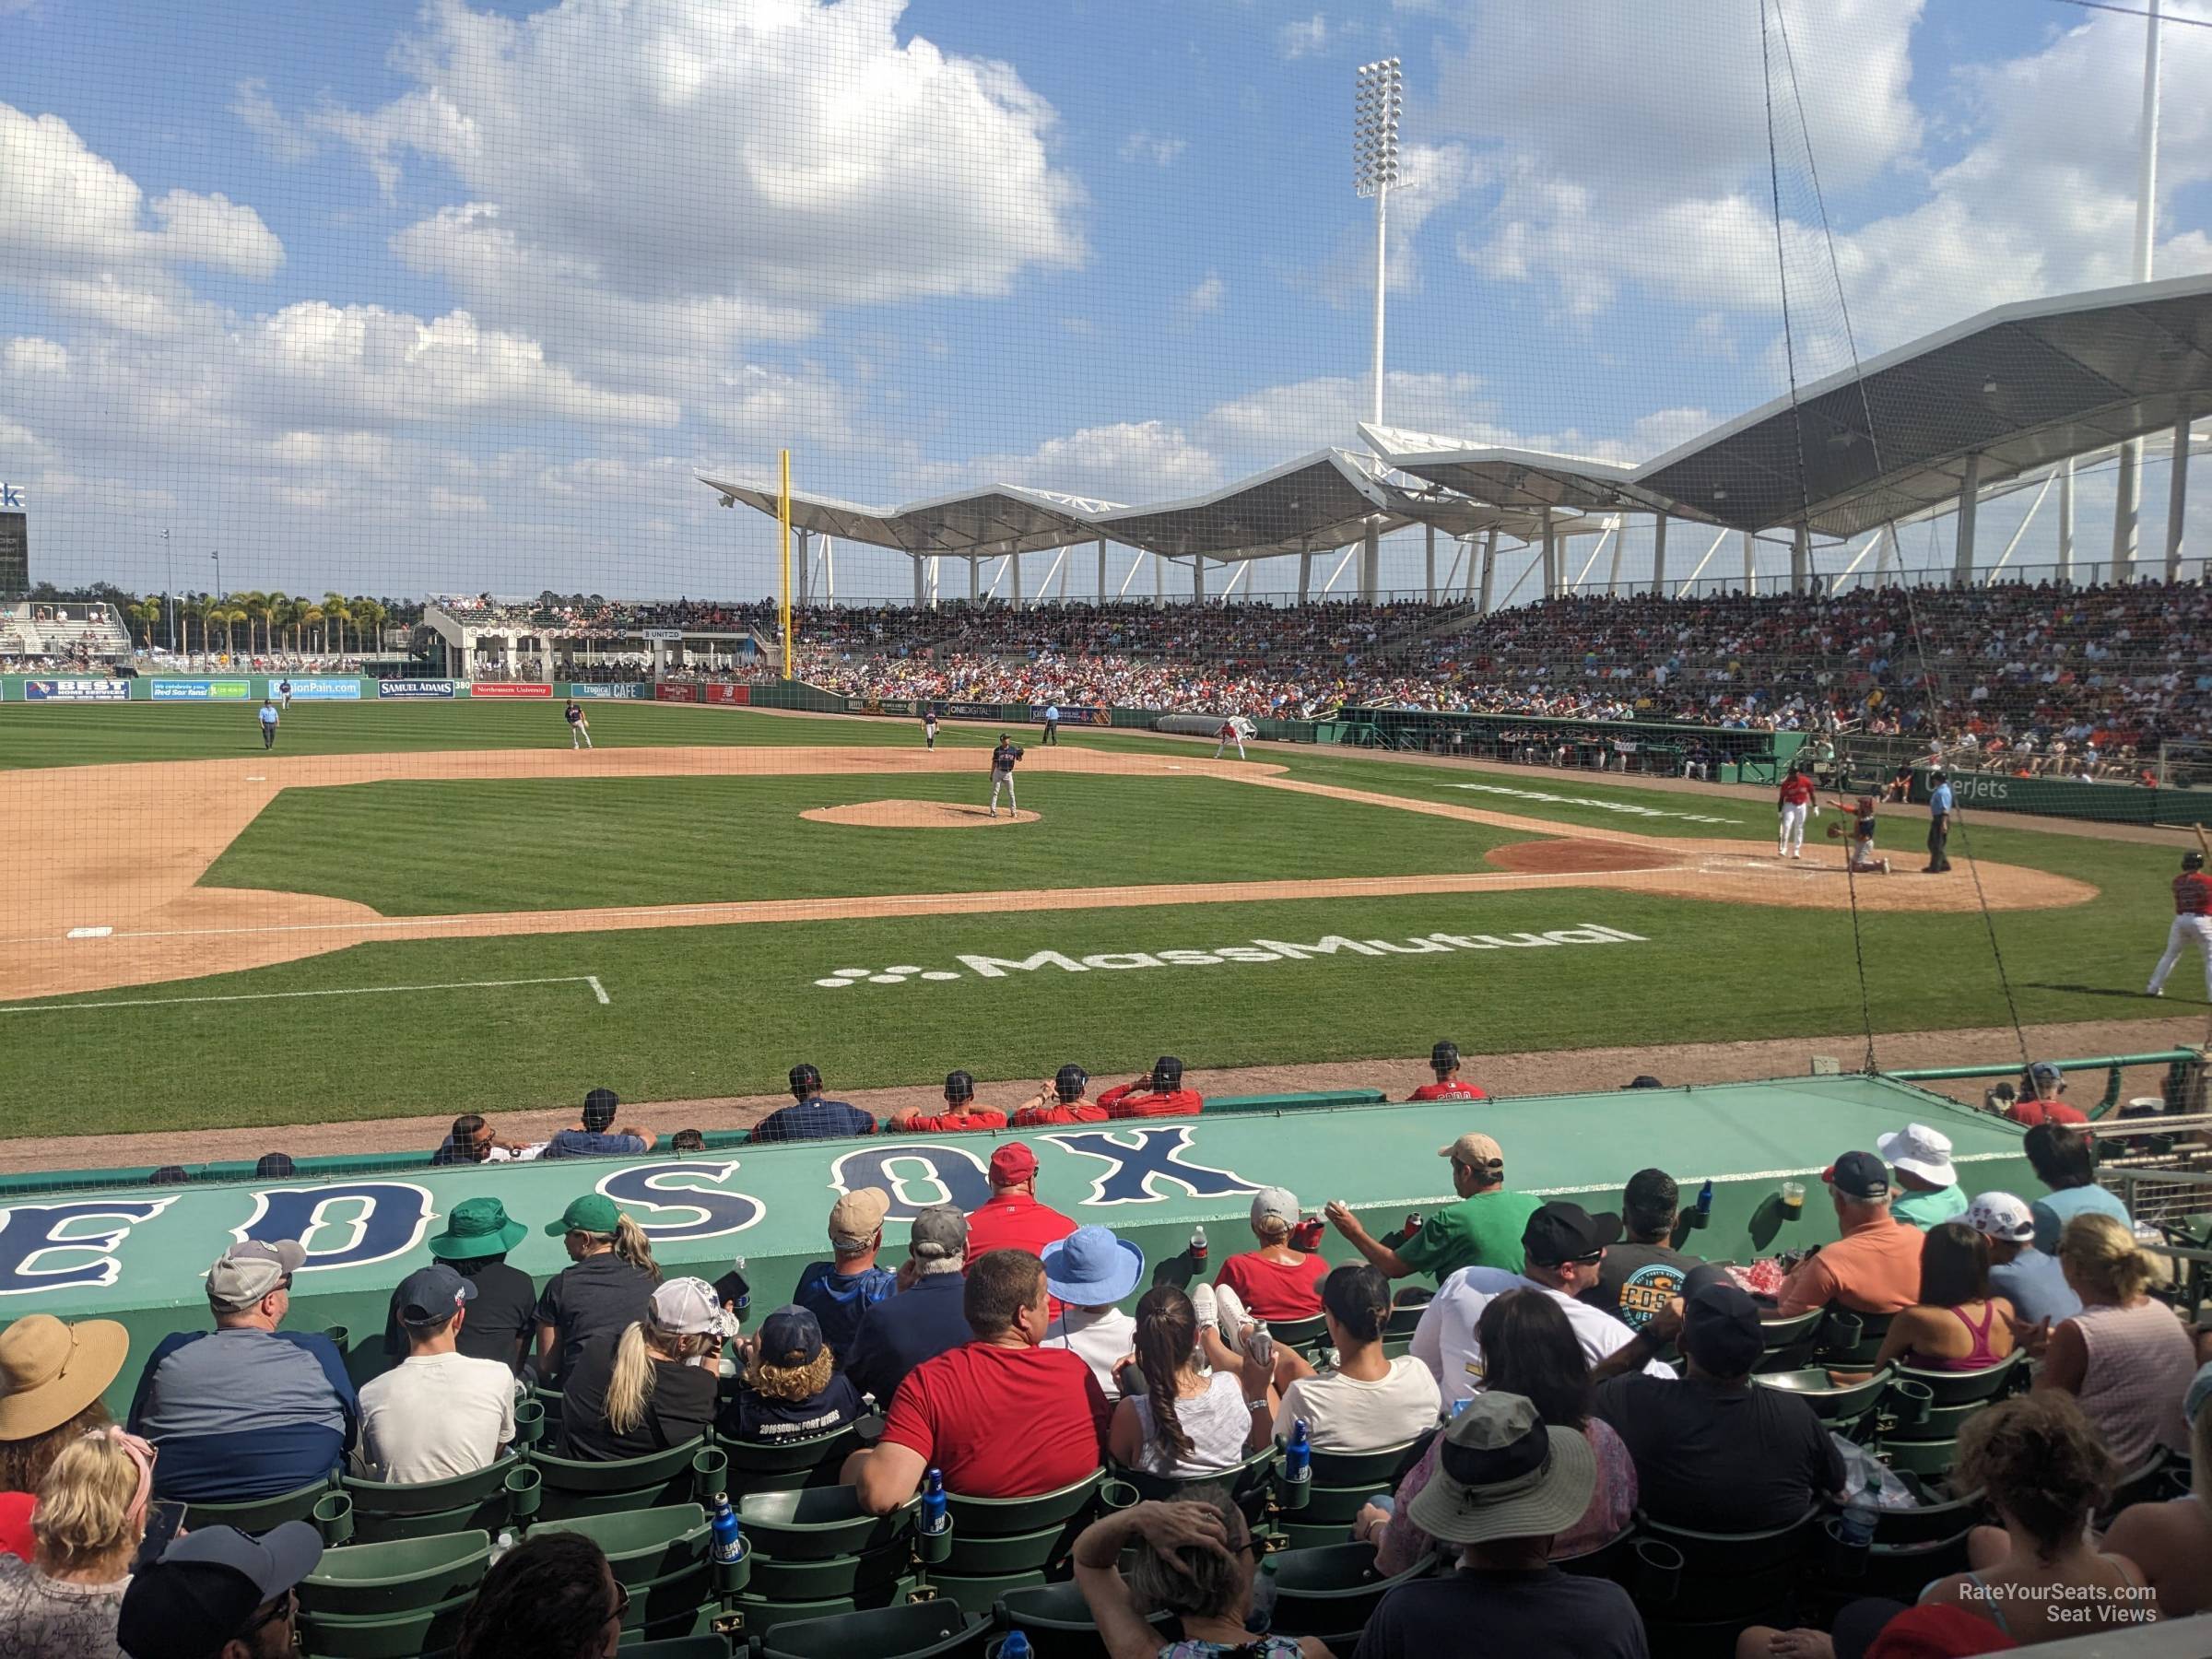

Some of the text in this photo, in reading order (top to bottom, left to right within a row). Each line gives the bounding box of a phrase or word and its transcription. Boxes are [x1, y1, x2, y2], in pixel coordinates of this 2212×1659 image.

[58, 681, 125, 690] BEST
[382, 682, 452, 693] SAMUEL ADAMS
[454, 681, 470, 689] 380
[516, 686, 547, 694] University
[1924, 773, 2008, 799] UerJets
[957, 923, 1652, 977] MassMutual
[802, 1418, 819, 1430] FORT
